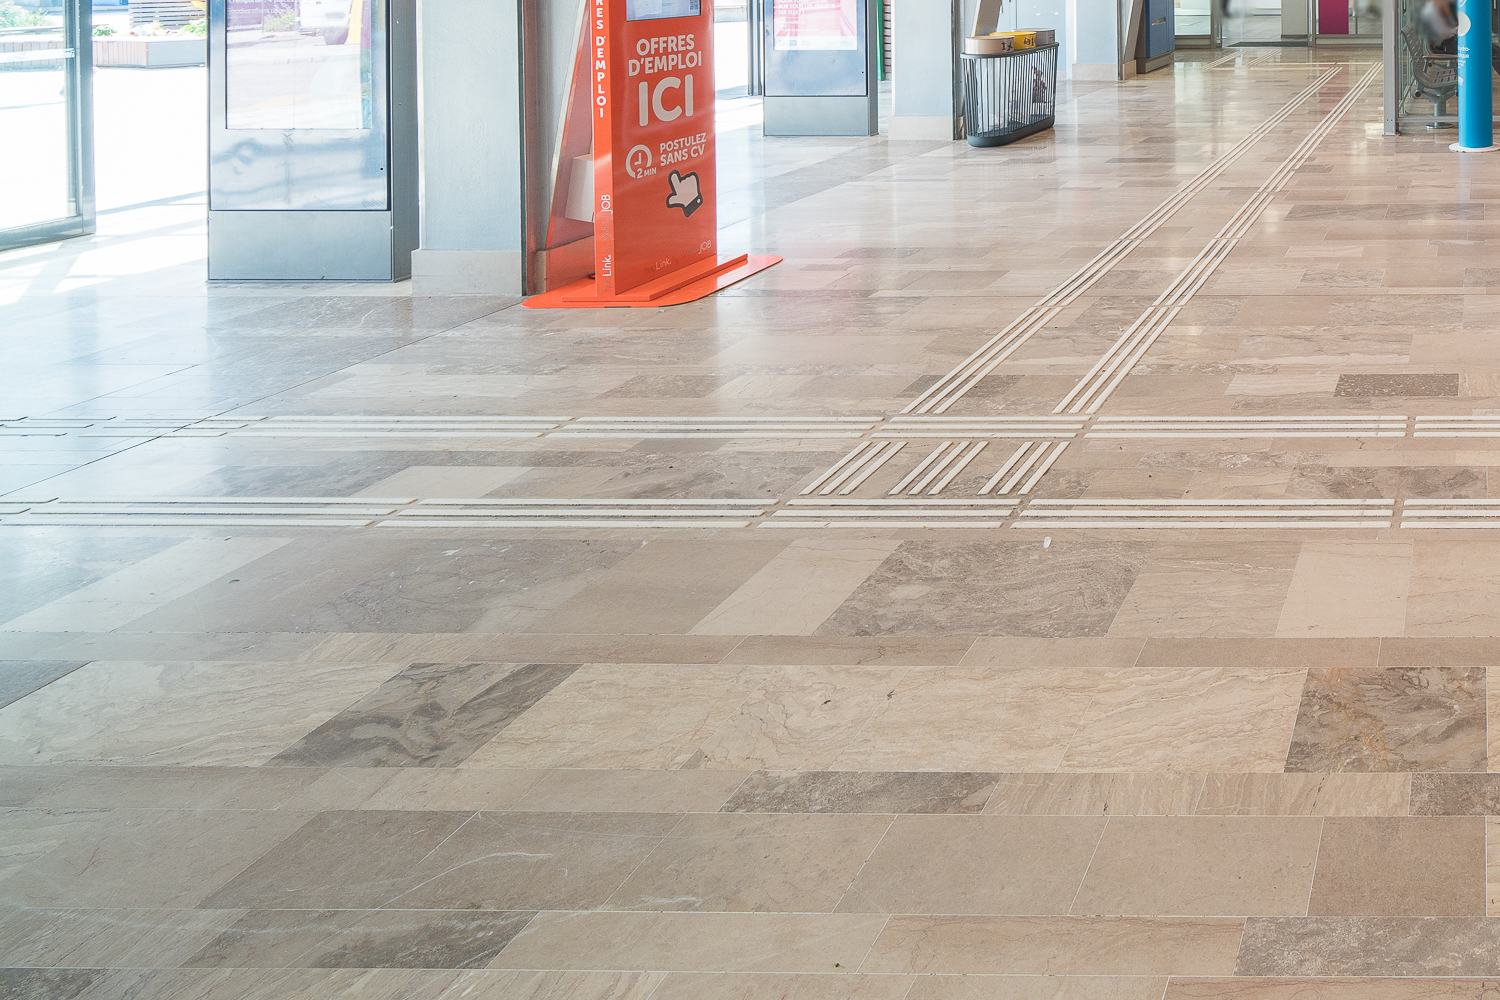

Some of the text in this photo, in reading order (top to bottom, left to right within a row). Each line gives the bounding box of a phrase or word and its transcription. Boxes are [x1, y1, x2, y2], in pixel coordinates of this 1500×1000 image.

[636, 34, 695, 56] OFFRES
[628, 50, 702, 77] D'EMPLOI
[595, 35, 607, 118] D'EMPLOI
[638, 74, 695, 127] ICI
[659, 132, 707, 153] POSTULEZ
[659, 144, 706, 167] SANS CV
[636, 167, 657, 179] 2 MIN
